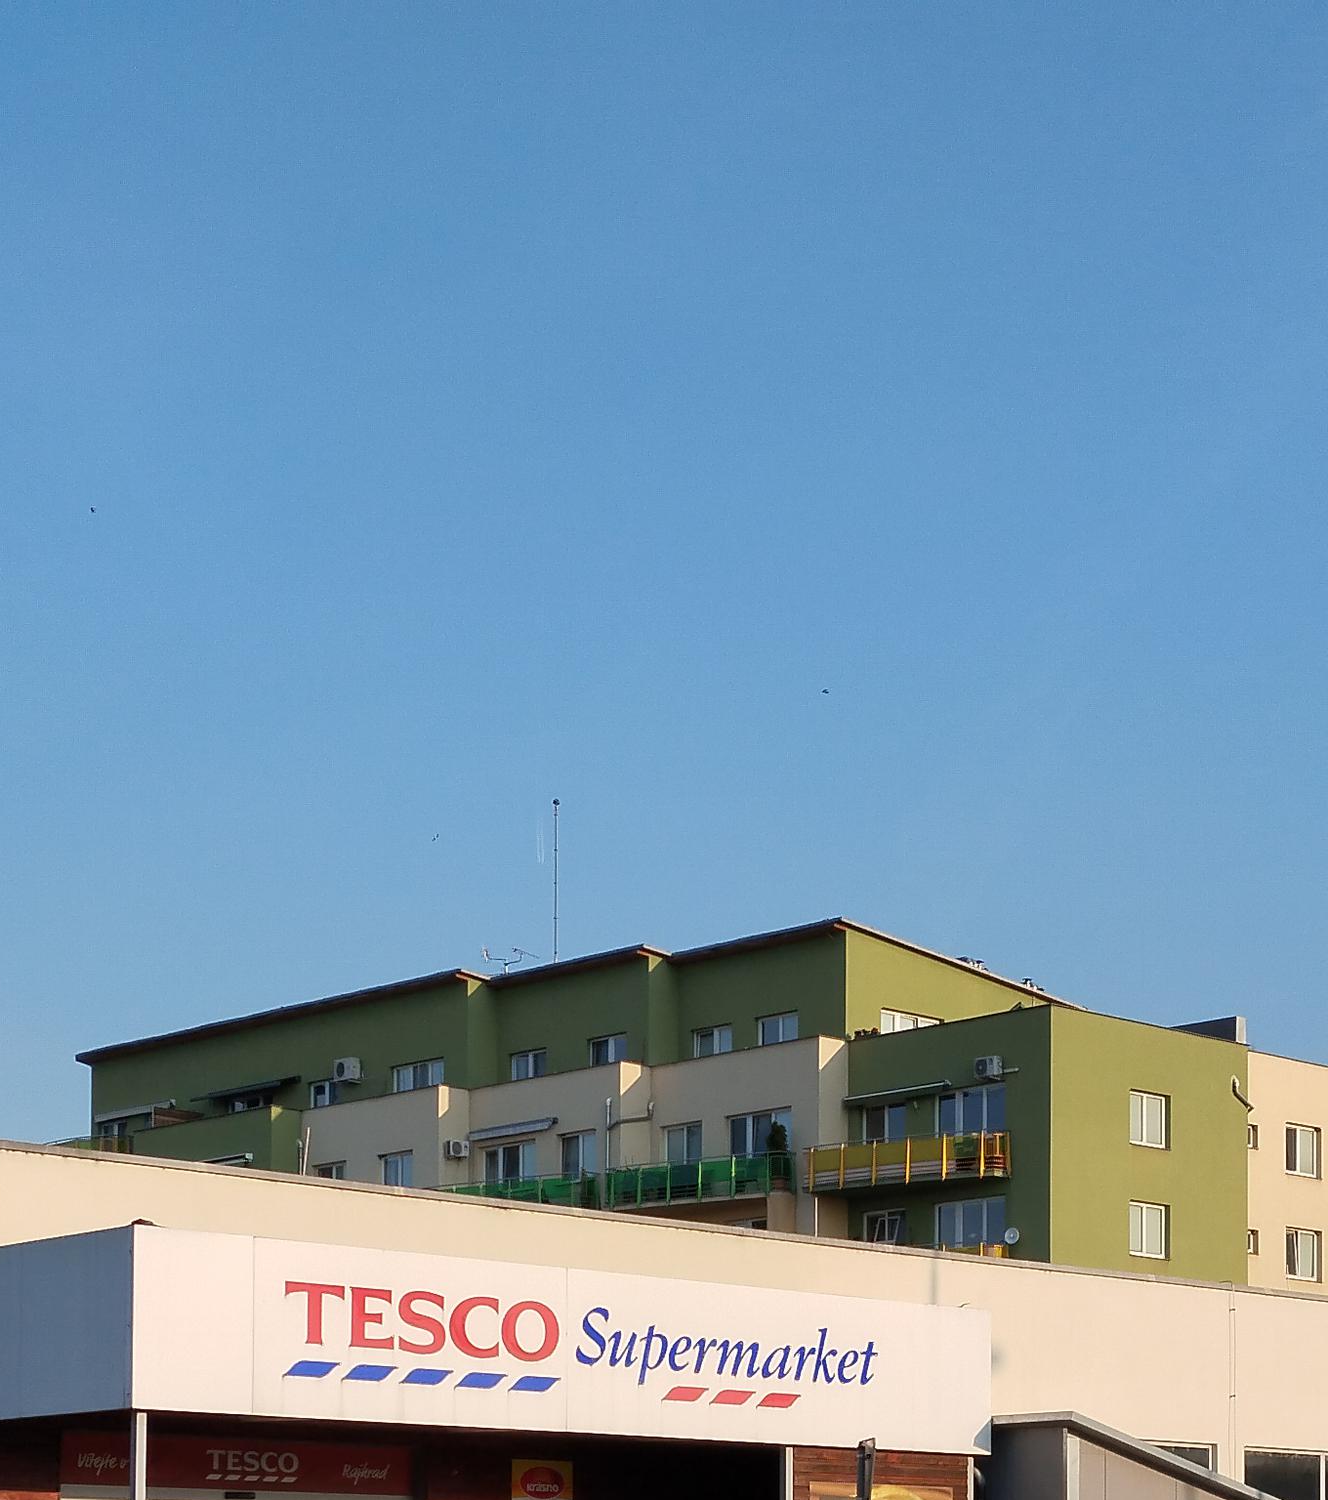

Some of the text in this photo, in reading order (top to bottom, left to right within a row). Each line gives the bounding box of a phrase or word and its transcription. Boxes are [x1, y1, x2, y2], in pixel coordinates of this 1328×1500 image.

[284, 1280, 879, 1386] TESCO Supermarket
[206, 1450, 299, 1474] TESCO
[342, 1464, 389, 1484] Rajhrad
